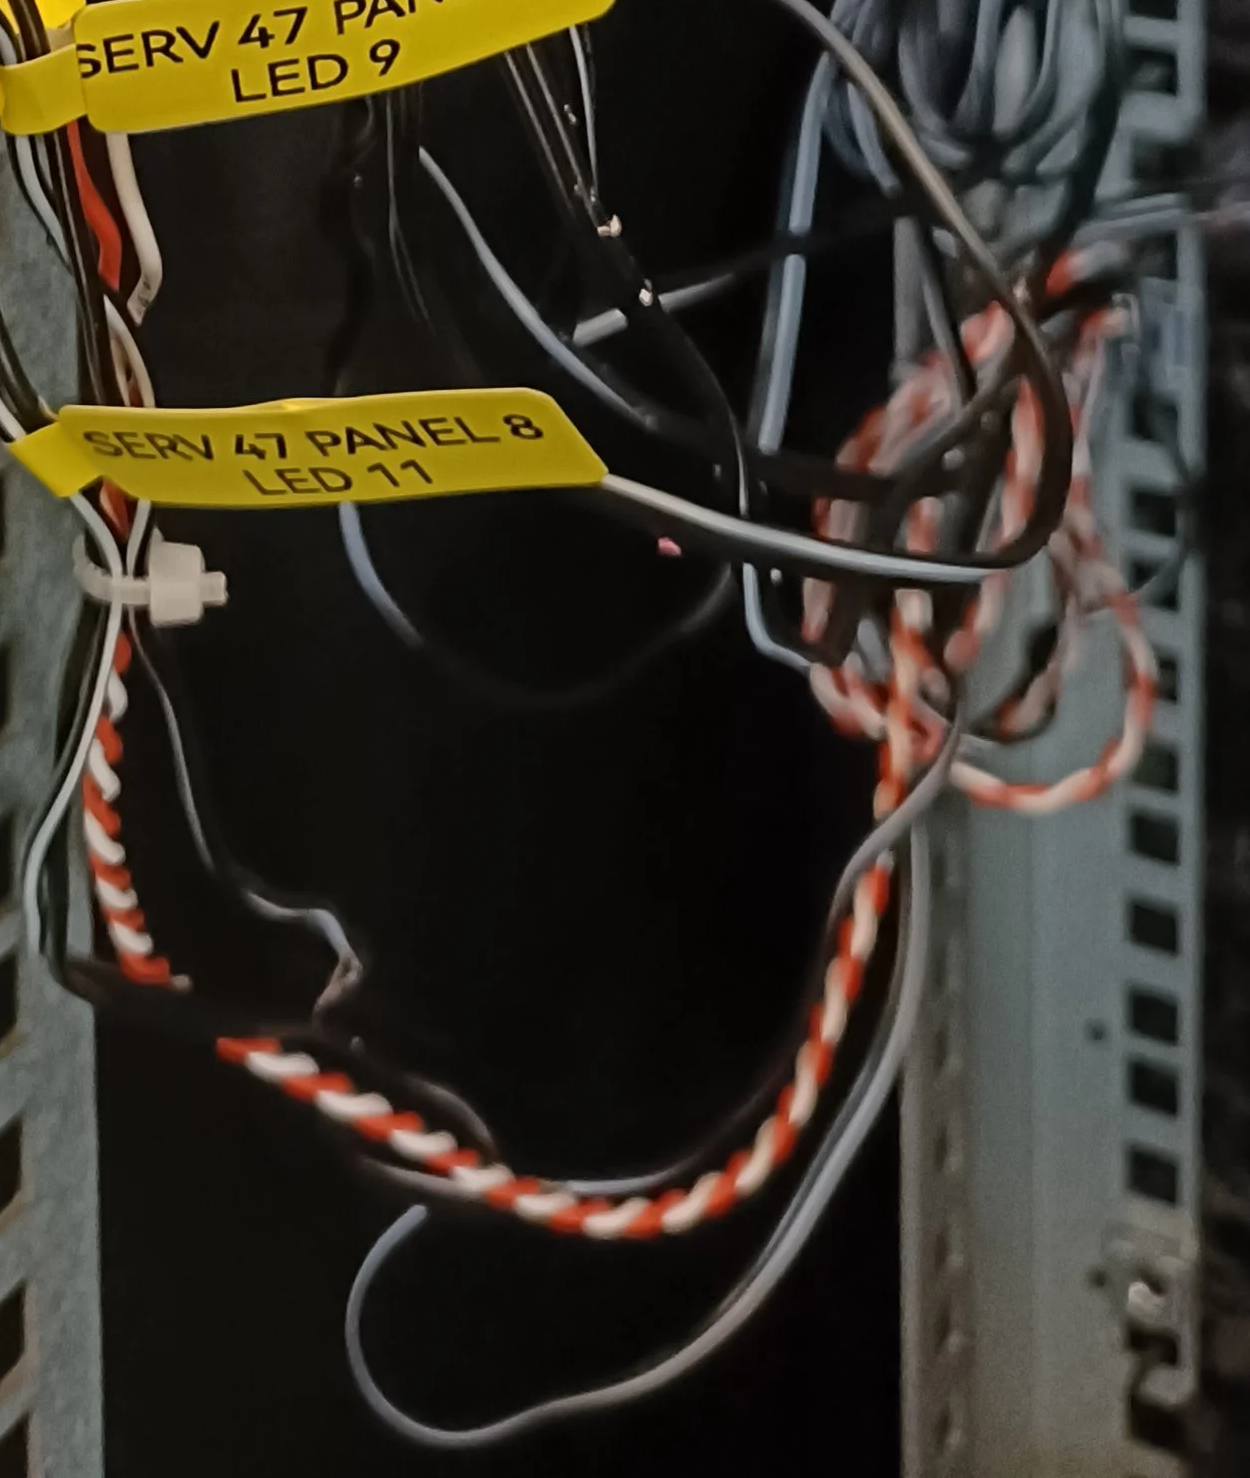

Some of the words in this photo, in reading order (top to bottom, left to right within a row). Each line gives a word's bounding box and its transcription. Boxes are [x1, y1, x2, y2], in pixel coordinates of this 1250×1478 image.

[77, 20, 220, 80] SERV
[236, 6, 306, 48] 47
[231, 50, 351, 105] LED
[364, 39, 403, 76] 9
[81, 426, 215, 463] SERV
[232, 430, 288, 462] 47
[304, 416, 503, 456] PANEL
[501, 413, 544, 442] 8
[241, 463, 358, 496] LED
[365, 458, 435, 486] 11
